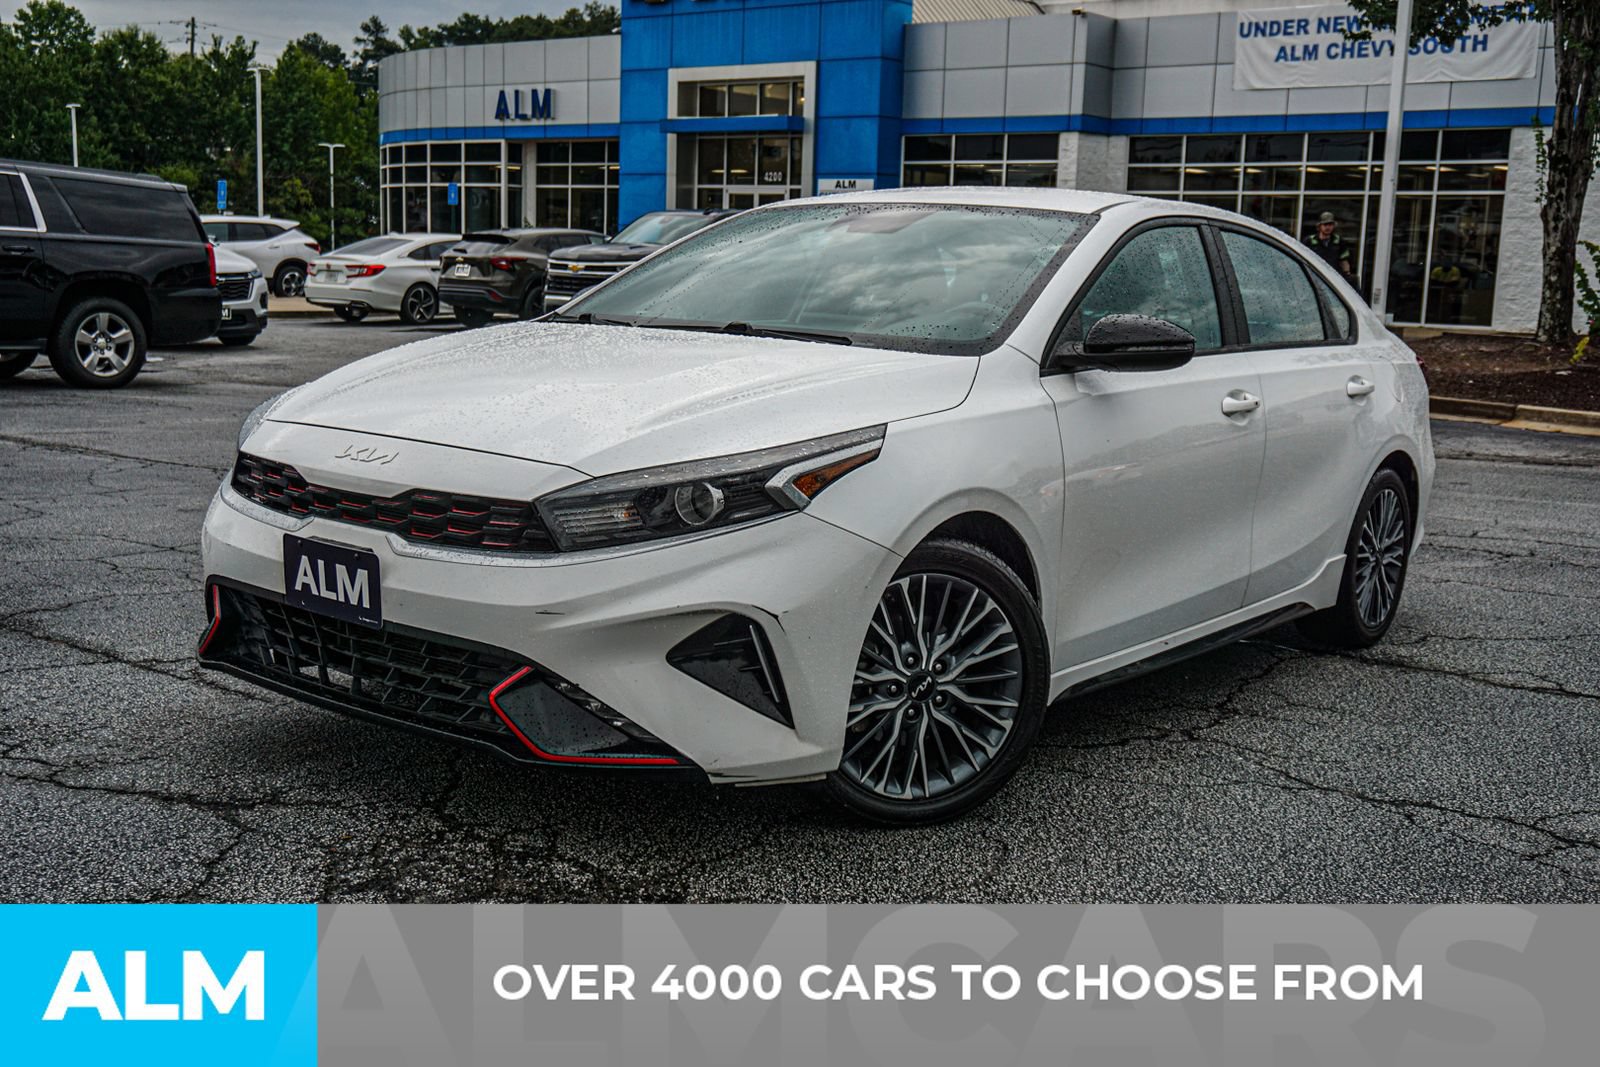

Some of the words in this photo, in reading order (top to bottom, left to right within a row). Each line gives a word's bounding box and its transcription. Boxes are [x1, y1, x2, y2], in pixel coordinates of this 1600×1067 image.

[1240, 18, 1309, 38] UNDER
[1317, 15, 1361, 34] NEW
[1275, 43, 1319, 62] ALM
[494, 88, 553, 120] ALM
[763, 171, 783, 182] 4200
[834, 180, 857, 189] ALM
[294, 554, 370, 609] ALM
